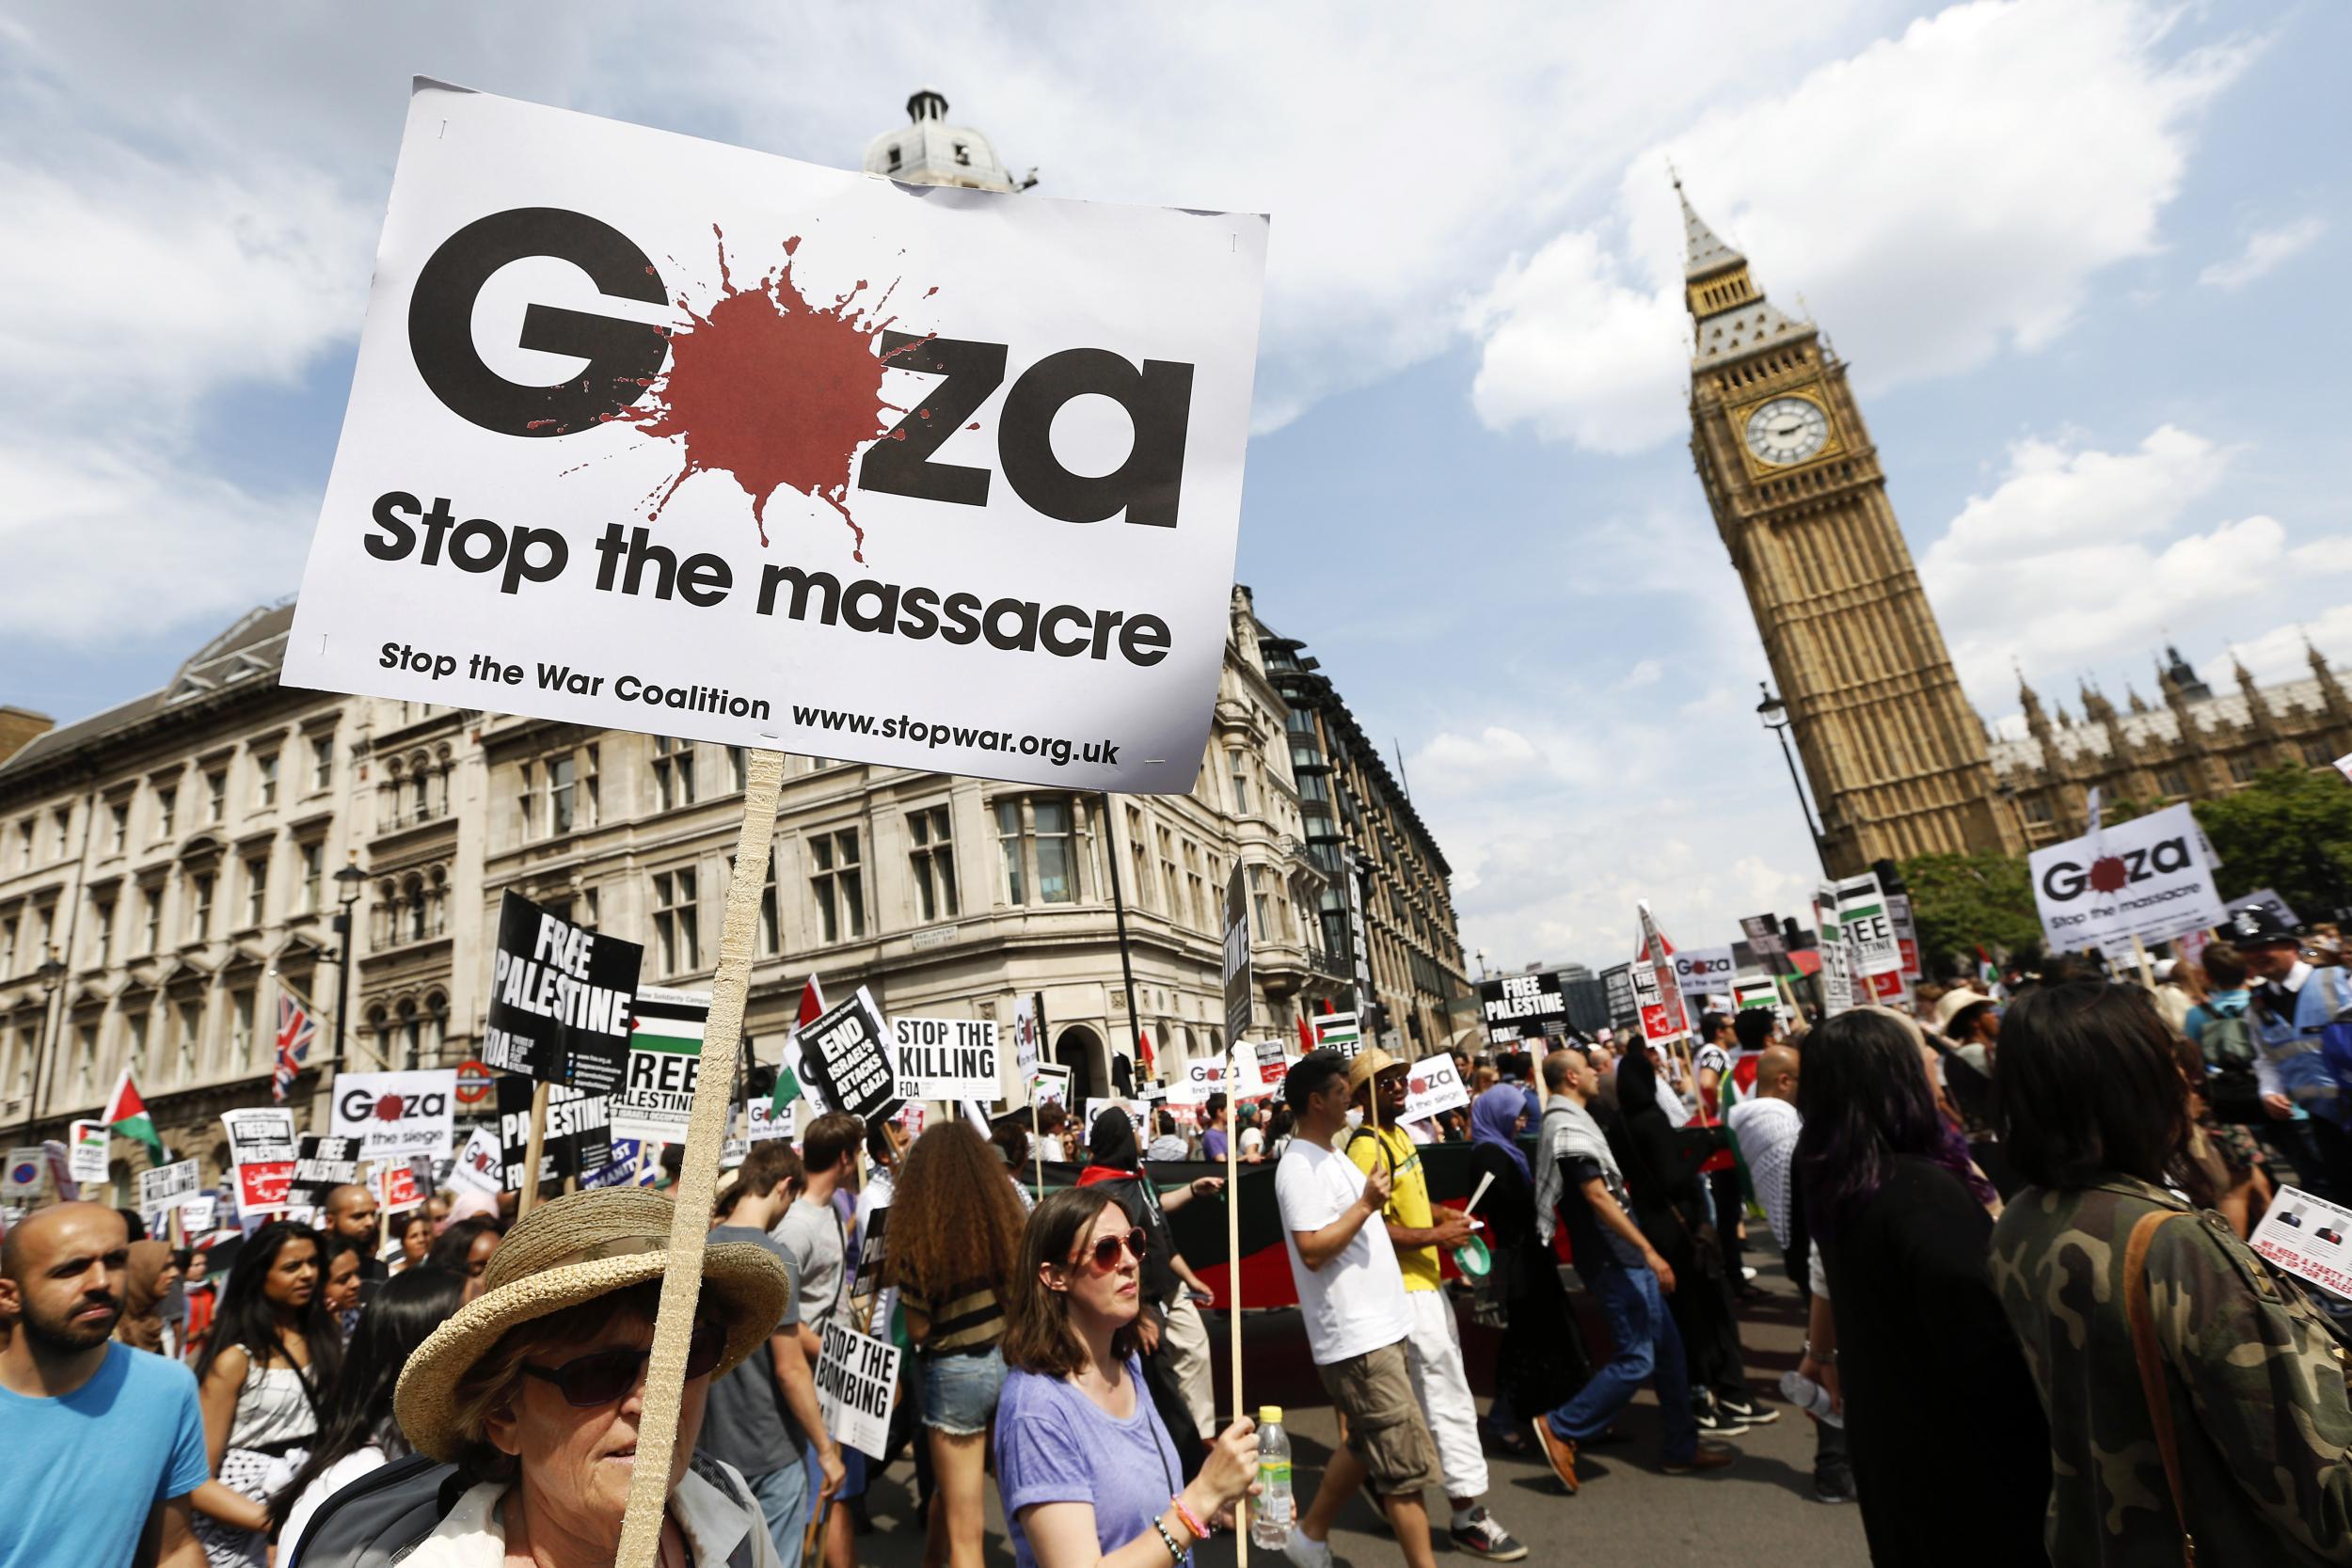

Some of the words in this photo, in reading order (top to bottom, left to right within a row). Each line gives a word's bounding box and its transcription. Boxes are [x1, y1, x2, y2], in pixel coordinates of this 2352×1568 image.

[408, 207, 1195, 529] Gza
[363, 490, 569, 595] Stop
[595, 522, 733, 608] the
[755, 563, 1172, 667] massacre
[379, 641, 457, 681] Stop
[469, 654, 524, 686] the
[536, 662, 605, 697] War
[614, 675, 771, 721] Coalition
[792, 705, 1120, 767] www.stopwar.org.uk
[2042, 836, 2191, 901] Gza
[2050, 912, 2087, 929] Stop
[2090, 905, 2116, 920] the
[2119, 882, 2201, 911] massacre
[533, 912, 595, 981] FREE
[1841, 916, 1890, 945] REE
[1677, 959, 1730, 975] Gza
[493, 947, 632, 1037] PALESTINE
[1502, 975, 1541, 999] FREE
[1485, 991, 1565, 1022] PALESTINE
[817, 1015, 864, 1064] END
[897, 1021, 949, 1045] STOP
[956, 1022, 993, 1047] THE
[629, 1053, 701, 1093] REE
[826, 1038, 876, 1082] ISRAEL'S
[835, 1053, 883, 1097] ATTACKS
[898, 1046, 995, 1079] KILLING
[1190, 1067, 1240, 1083] Gza
[341, 1089, 446, 1122] Gza
[613, 1089, 695, 1112] ALESTIN
[842, 1089, 863, 1111] ON
[859, 1068, 891, 1099] GAZA
[899, 1082, 920, 1098] FOA
[501, 1095, 610, 1149] PAESTINE
[750, 1107, 791, 1122] Ga
[315, 1138, 349, 1161] FREE
[372, 1132, 398, 1146] the
[403, 1130, 444, 1145] siege
[145, 1168, 172, 1186] STOP
[292, 1158, 358, 1185] PALESTINE
[505, 1163, 525, 1191] FO
[145, 1176, 196, 1203] KILLING
[2261, 1240, 2275, 1251] WE
[2276, 1245, 2300, 1261] NEED
[2312, 1260, 2344, 1281] PARTY
[2300, 1265, 2321, 1280] FOR
[823, 1321, 858, 1366] STOP
[859, 1338, 896, 1384] THE
[816, 1355, 889, 1421] BOMBING
